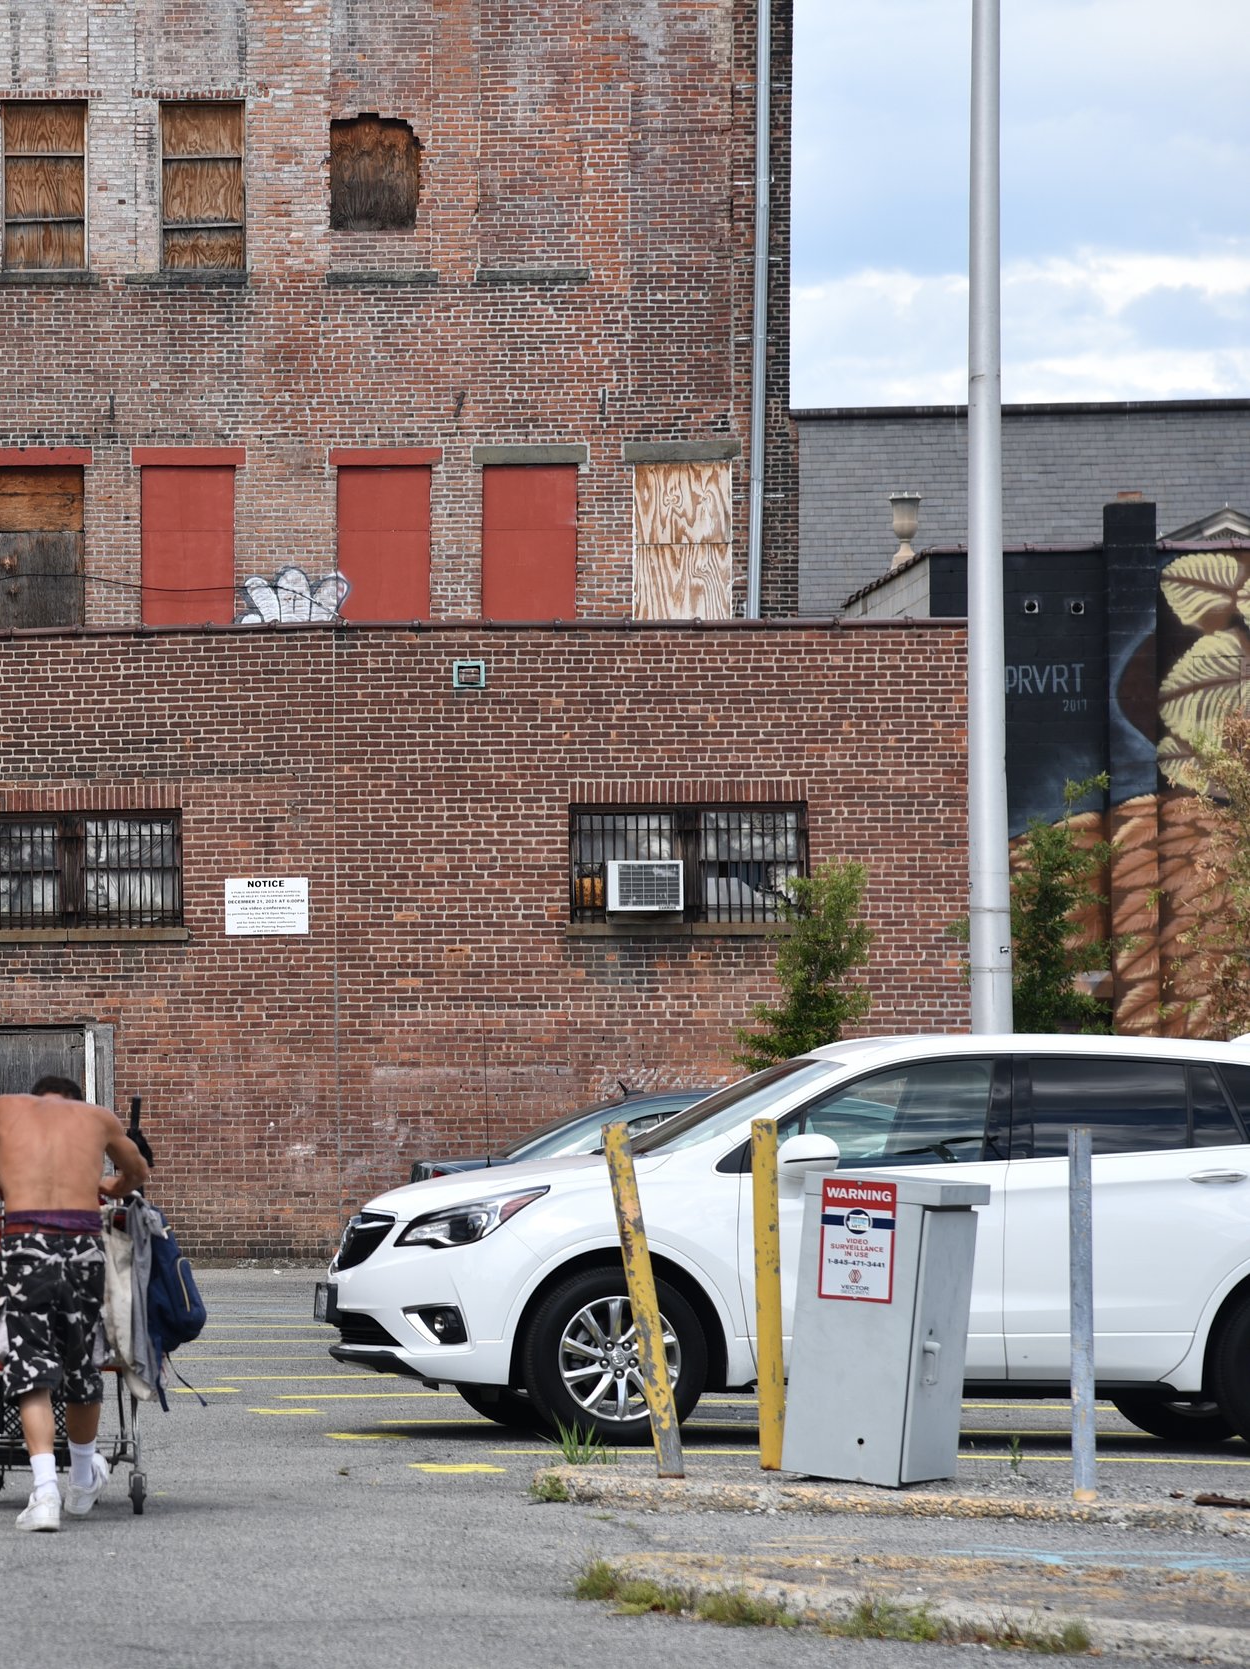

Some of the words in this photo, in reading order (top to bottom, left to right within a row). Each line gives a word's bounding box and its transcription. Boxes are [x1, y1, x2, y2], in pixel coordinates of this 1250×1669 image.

[1005, 663, 1085, 694] PRVRT
[1062, 699, 1087, 712] 2017
[247, 880, 285, 888] NOTICE
[826, 1186, 892, 1202] WARNING
[845, 1237, 868, 1245] VIDEO
[830, 1243, 884, 1253] SURVEILLANCE
[827, 1258, 885, 1268] 1-845-471-3441
